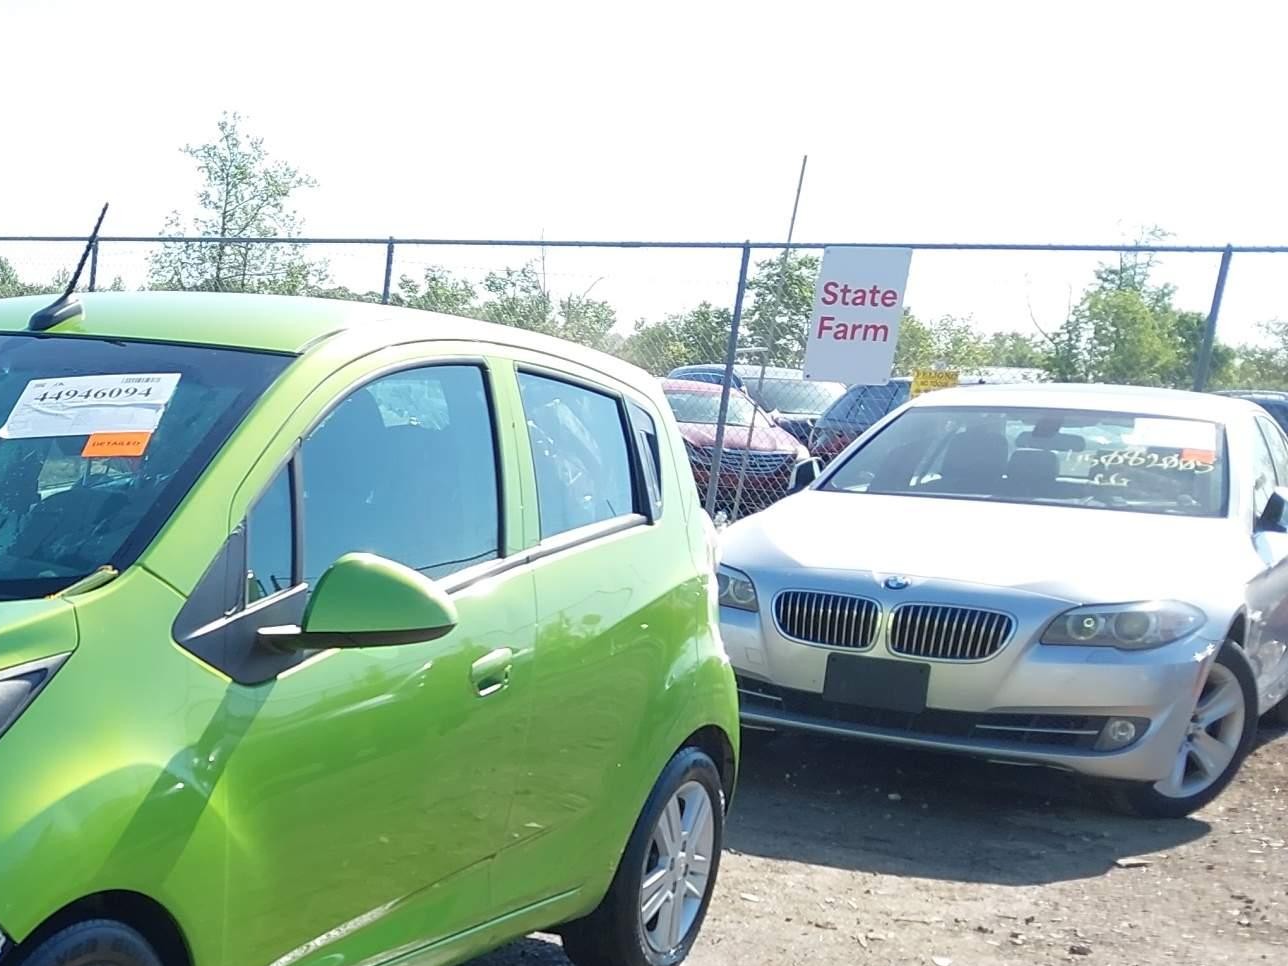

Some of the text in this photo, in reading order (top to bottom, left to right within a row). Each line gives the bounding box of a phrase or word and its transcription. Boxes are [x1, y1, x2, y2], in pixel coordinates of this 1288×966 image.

[821, 281, 898, 307] State
[817, 315, 889, 342] Farm
[34, 386, 153, 402] 44946094
